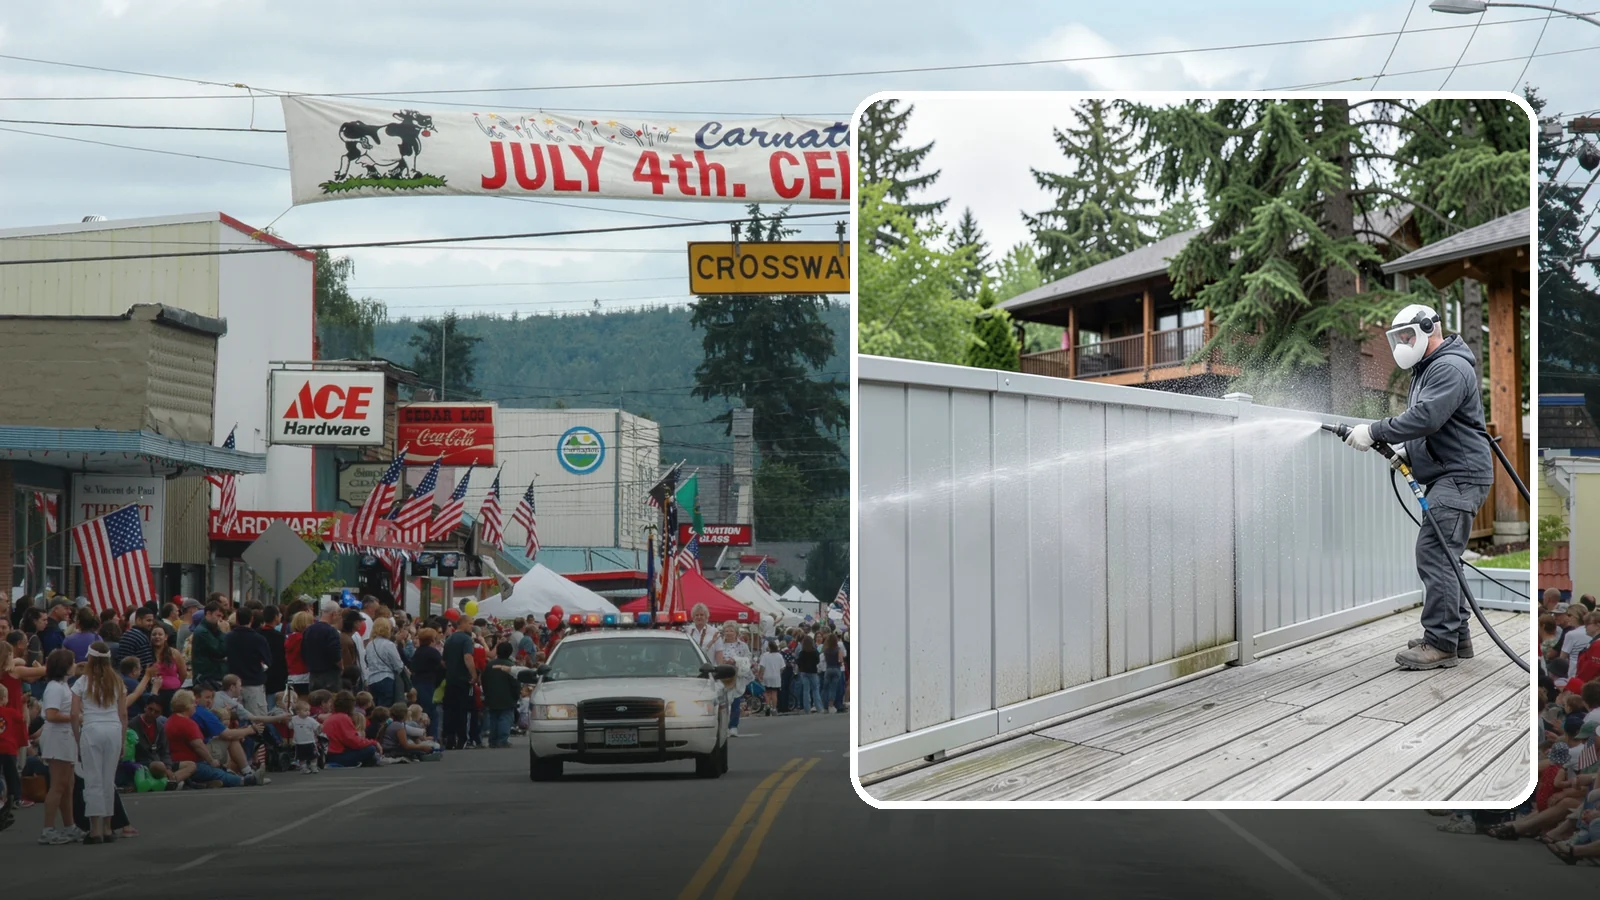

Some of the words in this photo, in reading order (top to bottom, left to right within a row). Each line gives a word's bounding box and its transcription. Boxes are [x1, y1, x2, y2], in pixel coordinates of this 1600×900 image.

[481, 140, 605, 192] JULY
[632, 150, 746, 198] 4th.
[696, 253, 850, 280] CROSSWA
[282, 379, 374, 420] ACE
[405, 409, 453, 422] CEDAR
[461, 409, 485, 421] LOG
[283, 421, 371, 436] Hardware
[83, 484, 94, 494] St.
[95, 484, 124, 495] Vincent
[125, 485, 136, 495] de
[137, 485, 155, 495] Paul
[212, 515, 330, 536] HARDARE
[688, 526, 741, 535] CRNATION
[699, 535, 730, 543] GLASS
